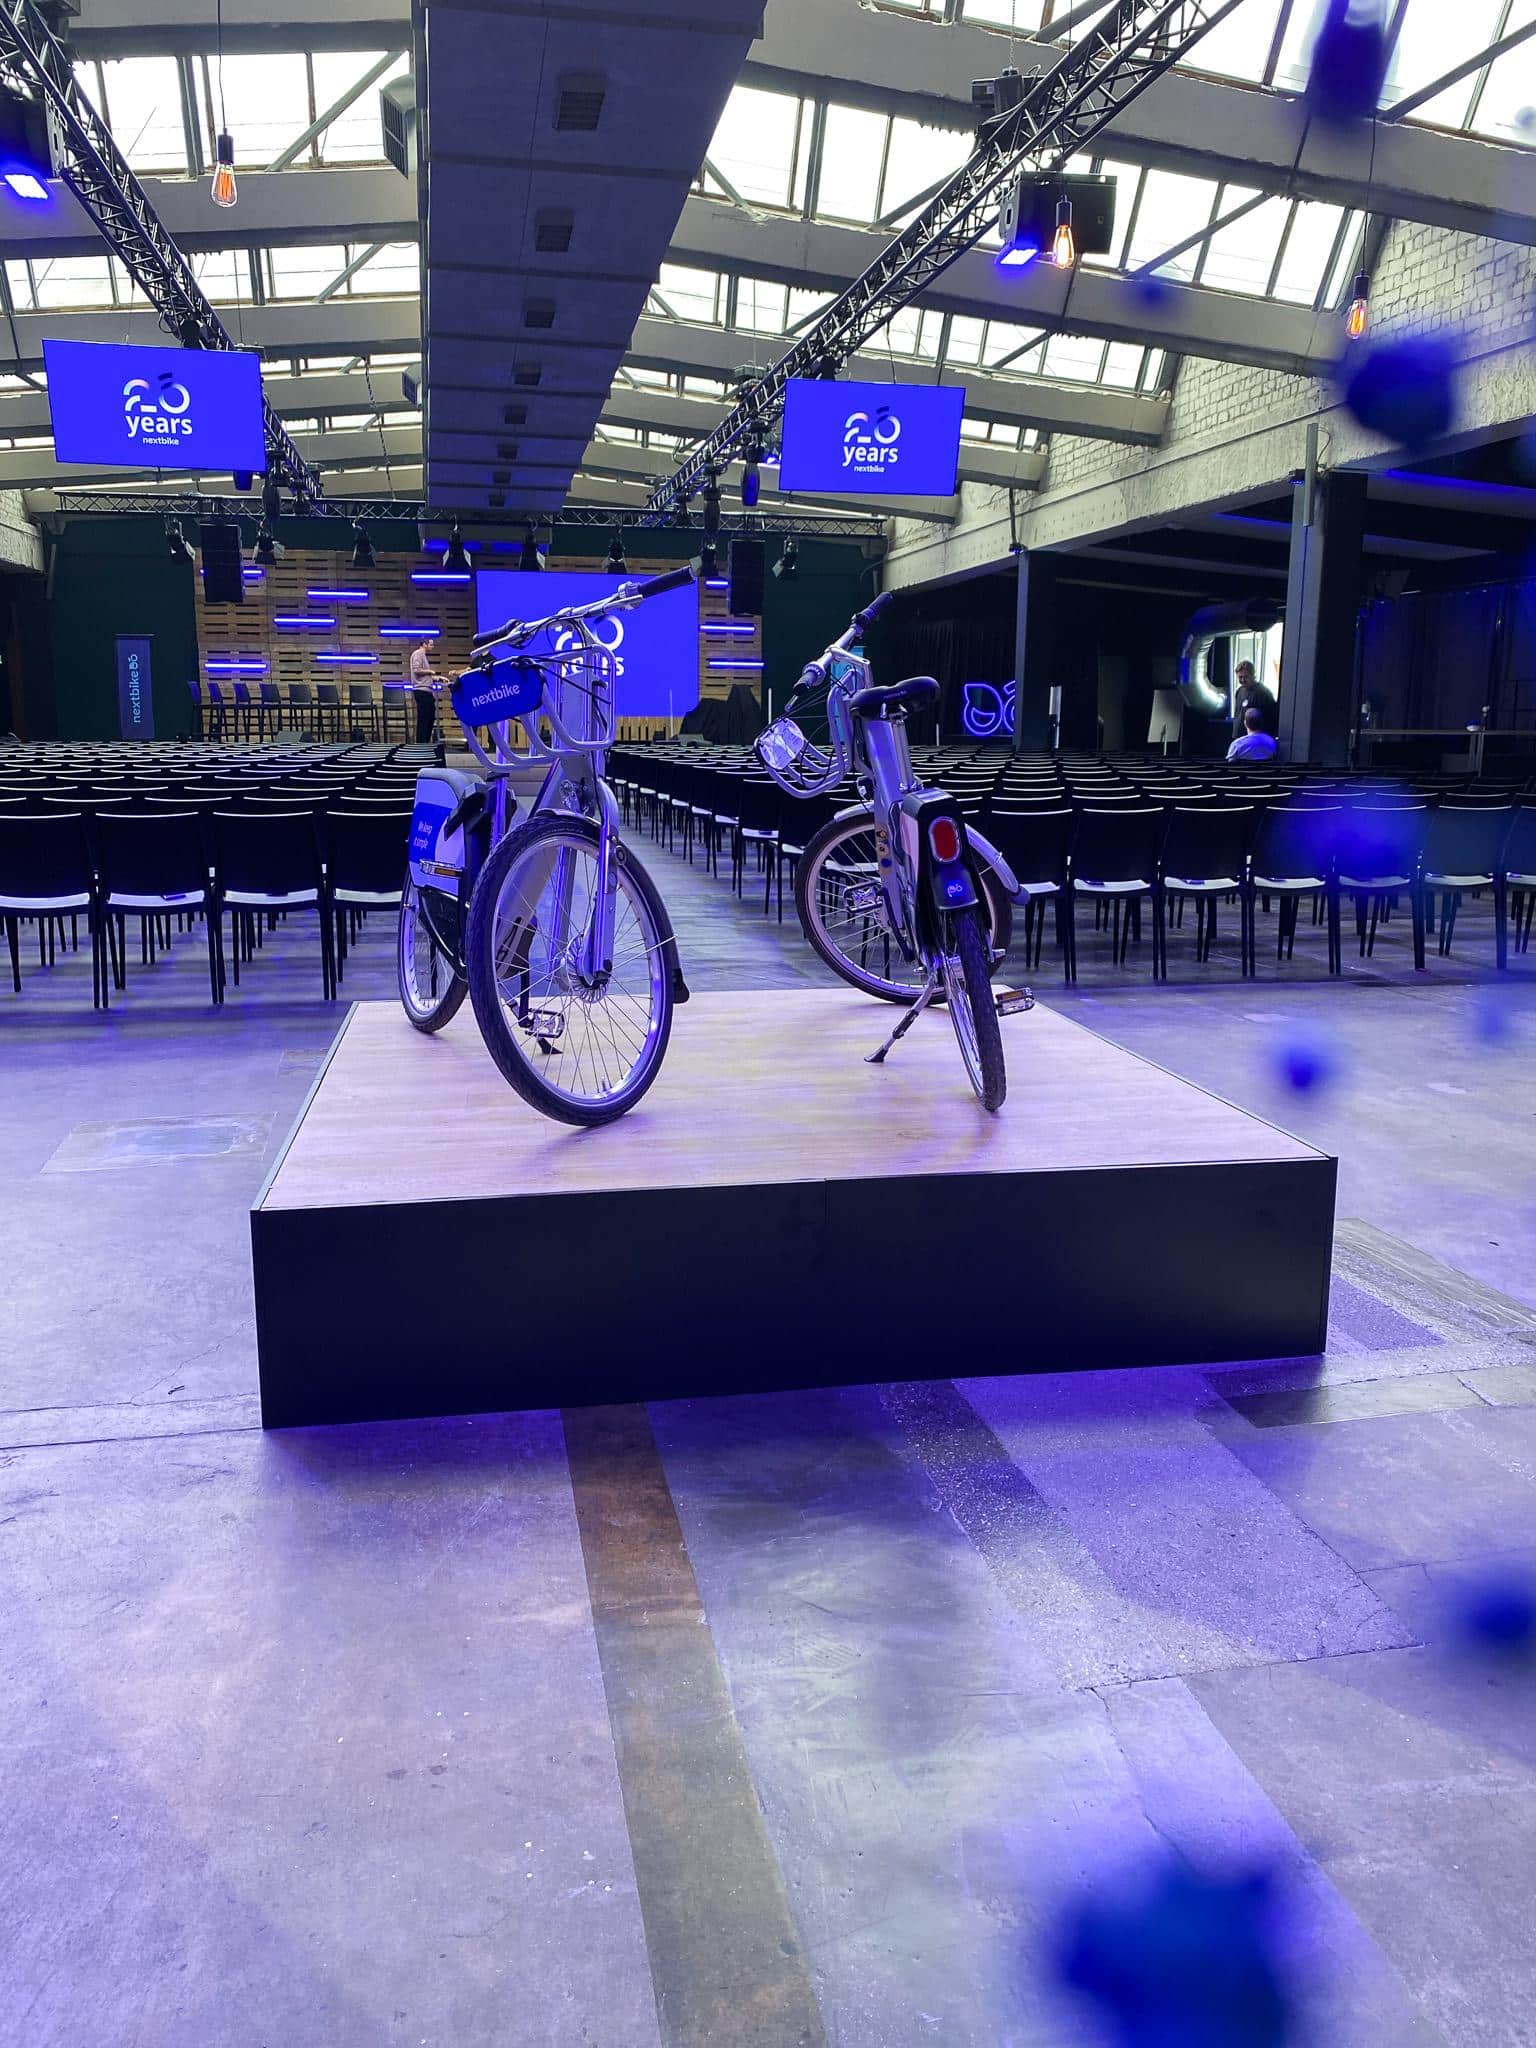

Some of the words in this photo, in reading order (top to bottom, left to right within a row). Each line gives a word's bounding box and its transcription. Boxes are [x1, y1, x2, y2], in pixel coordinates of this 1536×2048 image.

[125, 415, 193, 438] years
[143, 436, 180, 446] nextbike
[842, 444, 899, 467] years
[853, 464, 885, 473] nextbike
[129, 670, 141, 723] nextbike
[471, 684, 521, 707] nextbike
